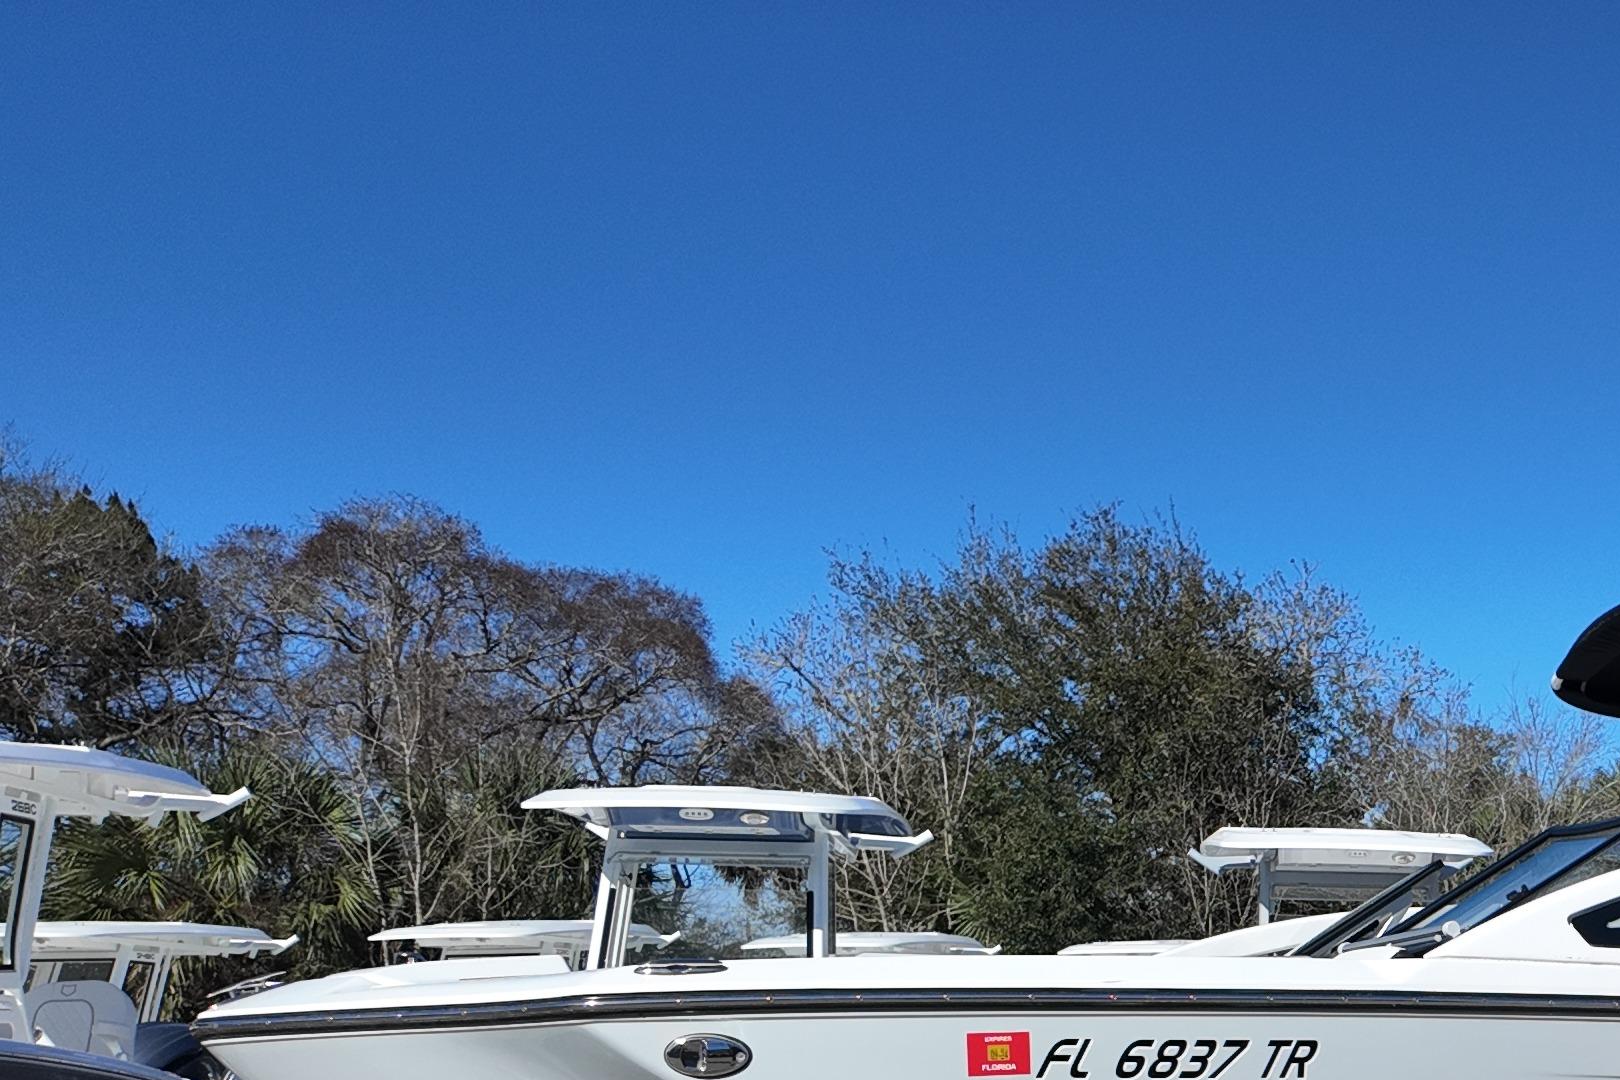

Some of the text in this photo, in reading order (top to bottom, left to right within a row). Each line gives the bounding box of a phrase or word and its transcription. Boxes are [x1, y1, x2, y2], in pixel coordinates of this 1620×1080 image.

[1035, 1038, 1319, 1080] FL 6837 TR
